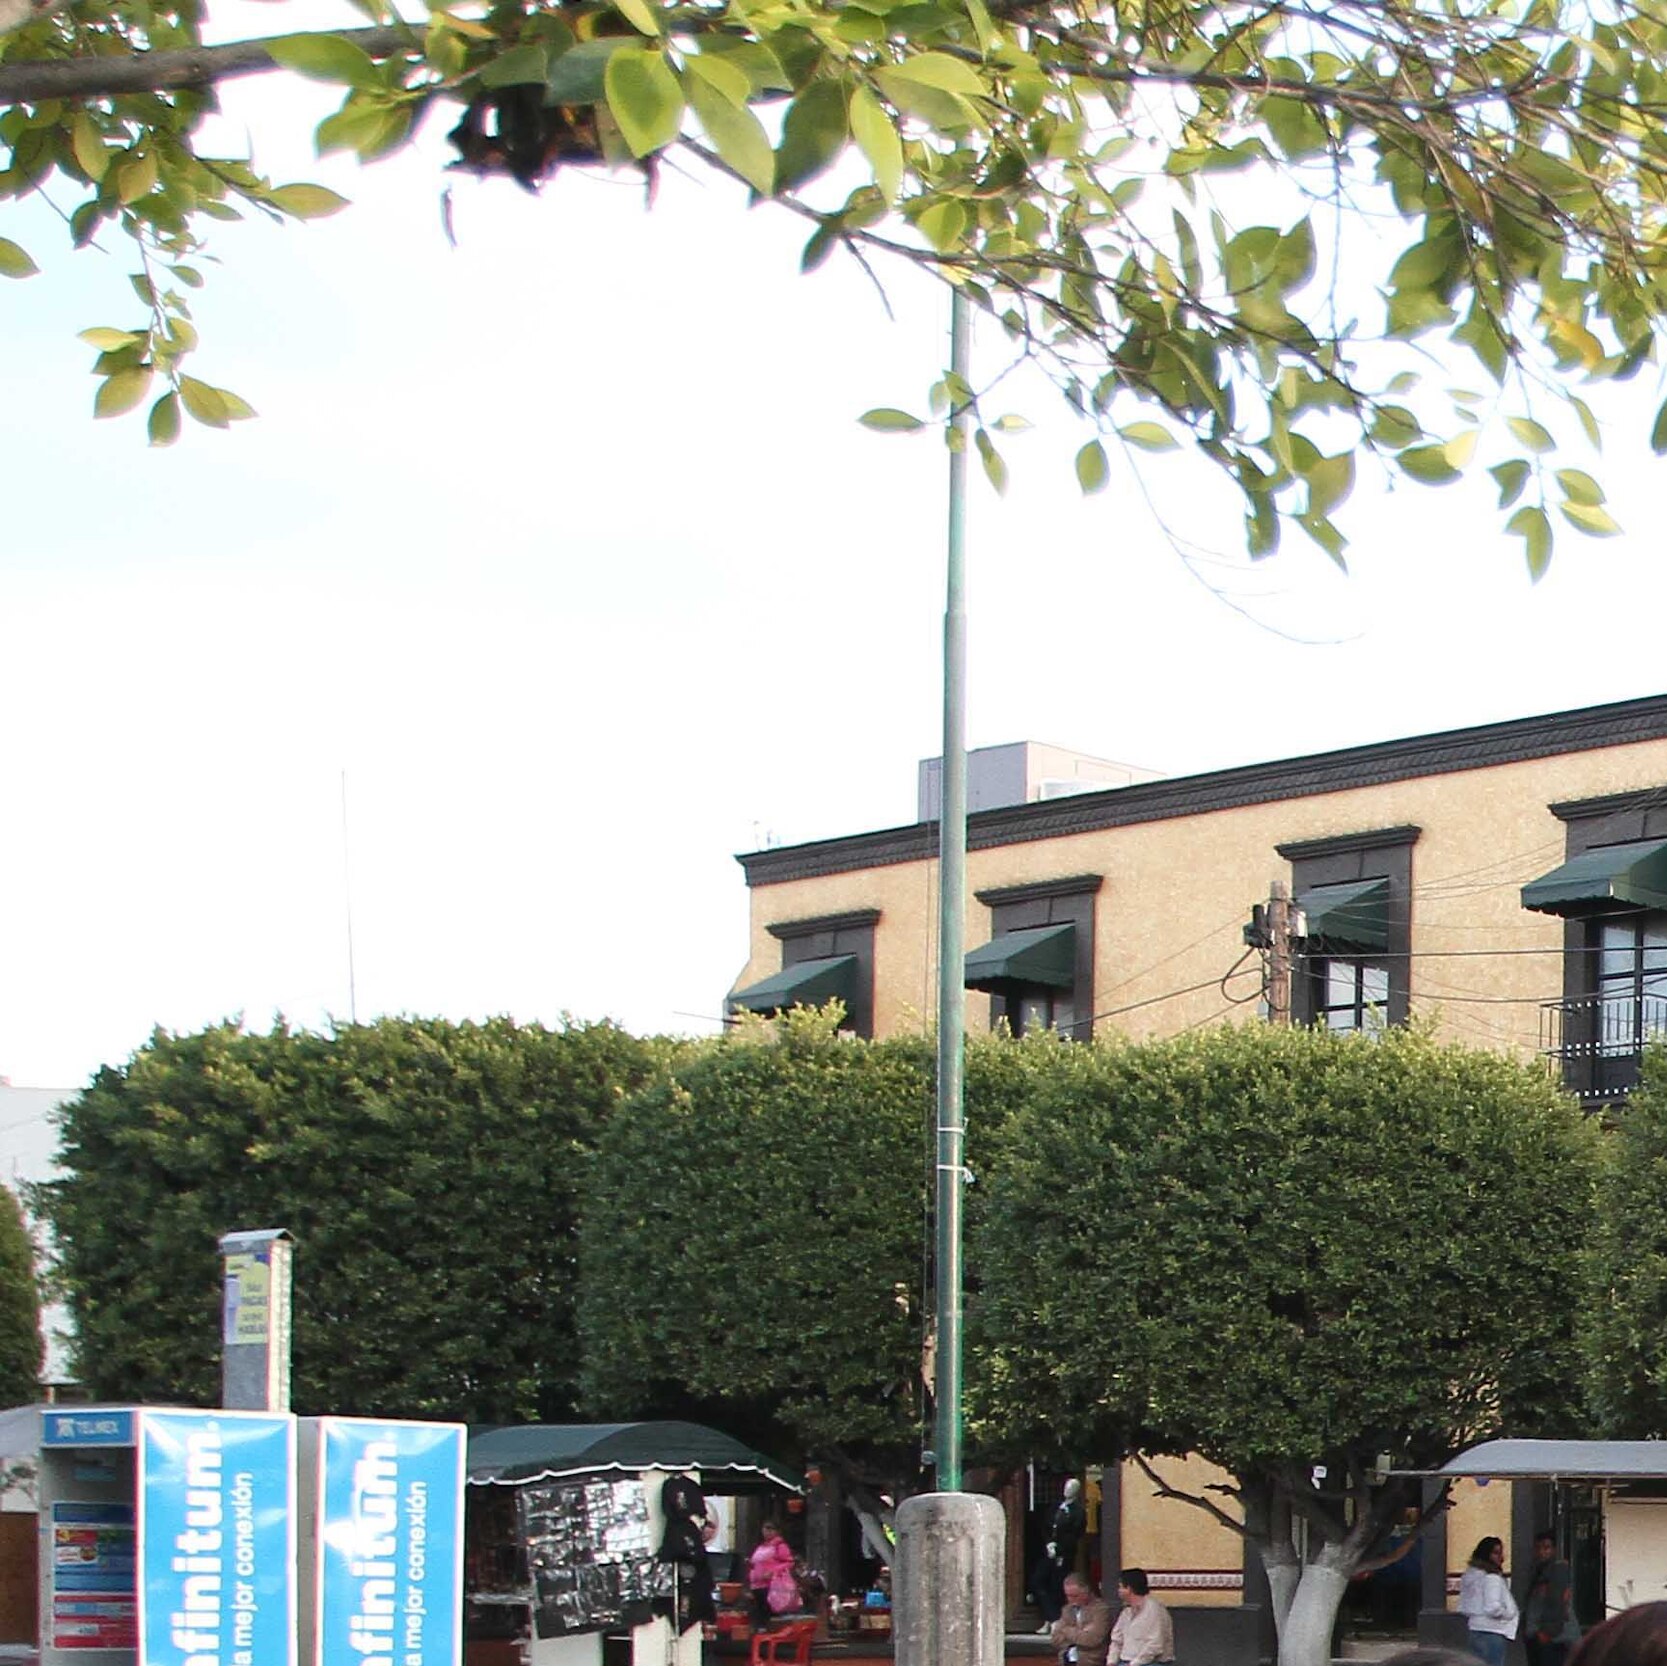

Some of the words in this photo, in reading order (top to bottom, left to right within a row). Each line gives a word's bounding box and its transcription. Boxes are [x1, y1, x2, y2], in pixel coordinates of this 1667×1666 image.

[231, 1472, 255, 1577] conexión
[405, 1480, 427, 1581] conexión
[231, 1581, 258, 1647] mejor
[403, 1586, 427, 1648] mejor
